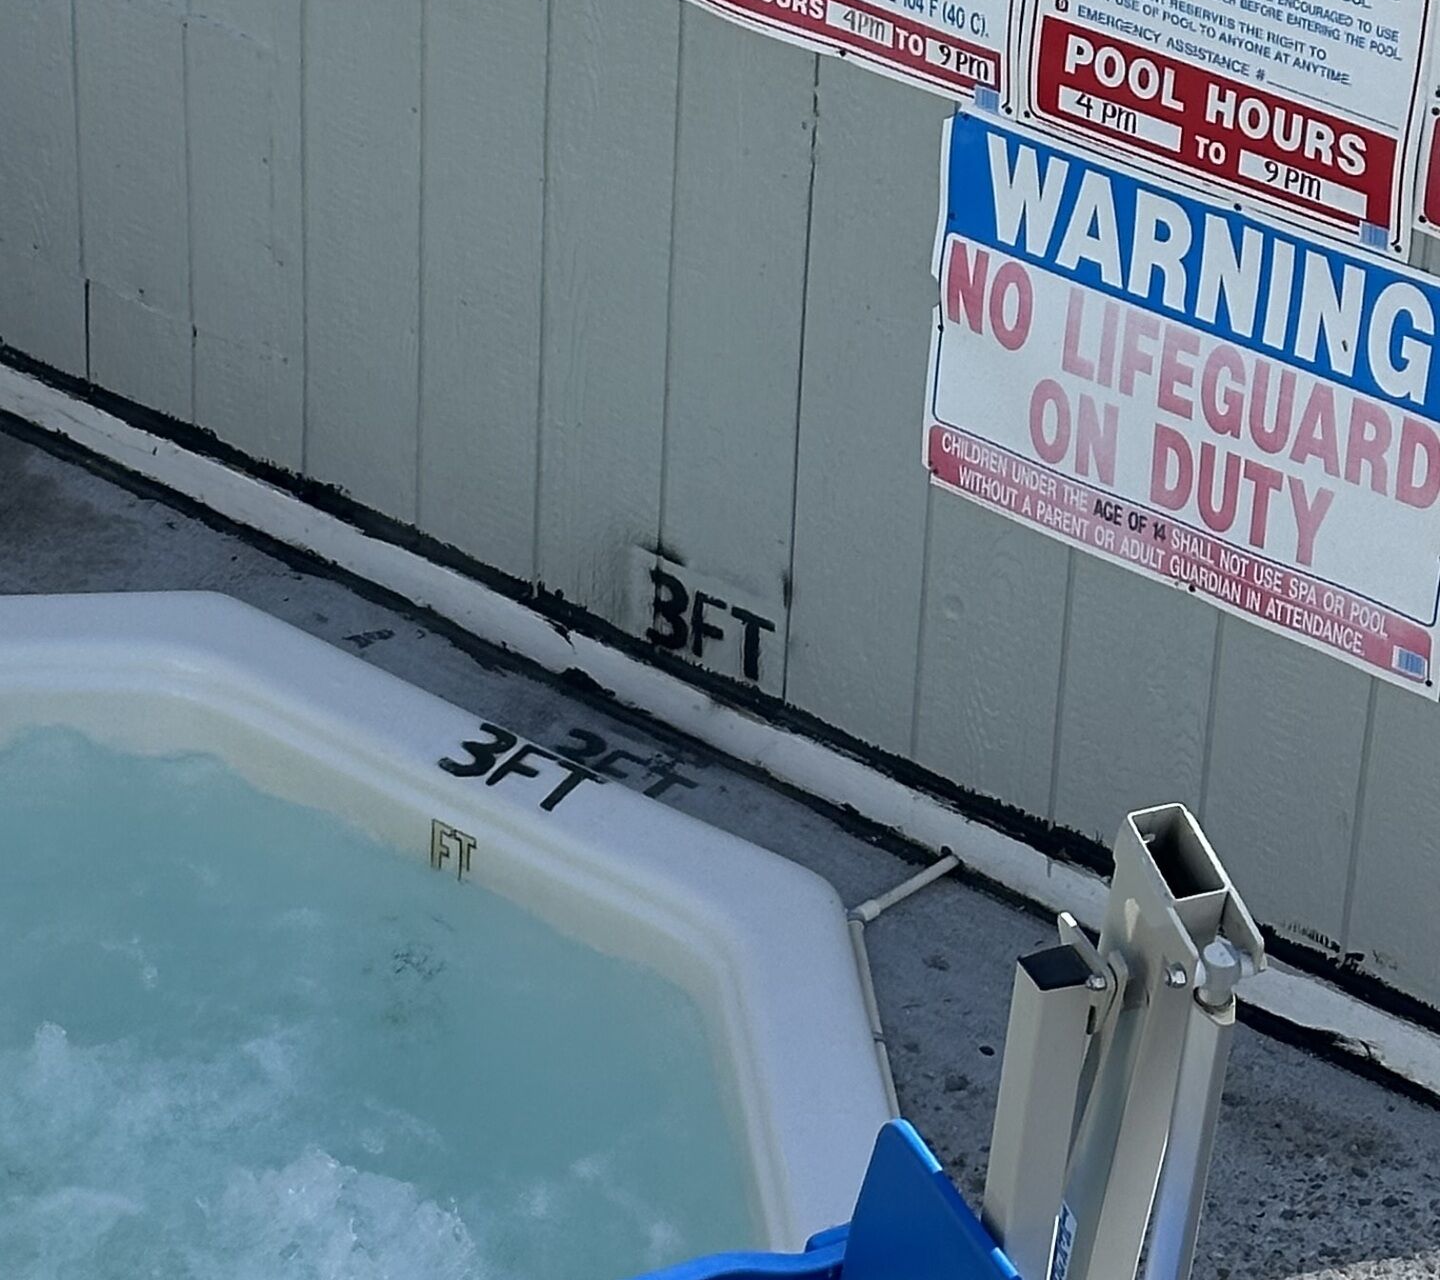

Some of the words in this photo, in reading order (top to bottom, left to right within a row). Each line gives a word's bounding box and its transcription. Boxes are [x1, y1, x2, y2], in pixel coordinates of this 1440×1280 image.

[895, 26, 924, 57] TO
[936, 39, 955, 66] 9
[942, 1, 966, 30] (40
[970, 12, 989, 38] C).
[1064, 33, 1184, 112] POOL
[1205, 83, 1367, 176] HOURS
[1074, 89, 1099, 119] 4
[1195, 135, 1226, 165] TO
[1261, 160, 1281, 190] 9
[986, 131, 1435, 406] WARNING
[946, 238, 1033, 352] NO
[1061, 288, 1440, 510] LIFEGUARD
[941, 432, 1009, 478] CHILDREN
[1011, 460, 1058, 501] UNDER
[1062, 483, 1089, 514] THE
[1092, 498, 1123, 527] AGE
[1127, 511, 1148, 535] OF
[1152, 521, 1167, 544] 14
[1170, 527, 1218, 570] SHALL
[1219, 548, 1250, 582] NOT
[1249, 562, 1286, 598] USE
[1284, 577, 1320, 611] SPA
[1322, 590, 1349, 623] OR
[1347, 598, 1388, 641] POOL
[959, 464, 1019, 508] WITHOUT
[1020, 493, 1032, 516] A
[1036, 499, 1093, 539] PARENT
[1091, 518, 1121, 551] OR
[1117, 530, 1166, 570] ADULT
[1169, 554, 1242, 604] GUARDIAN
[1245, 587, 1261, 612] IN
[1029, 379, 1118, 487] ON
[1149, 422, 1334, 568] DUTY
[647, 568, 776, 681] 3FT
[438, 723, 607, 812] 3FT
